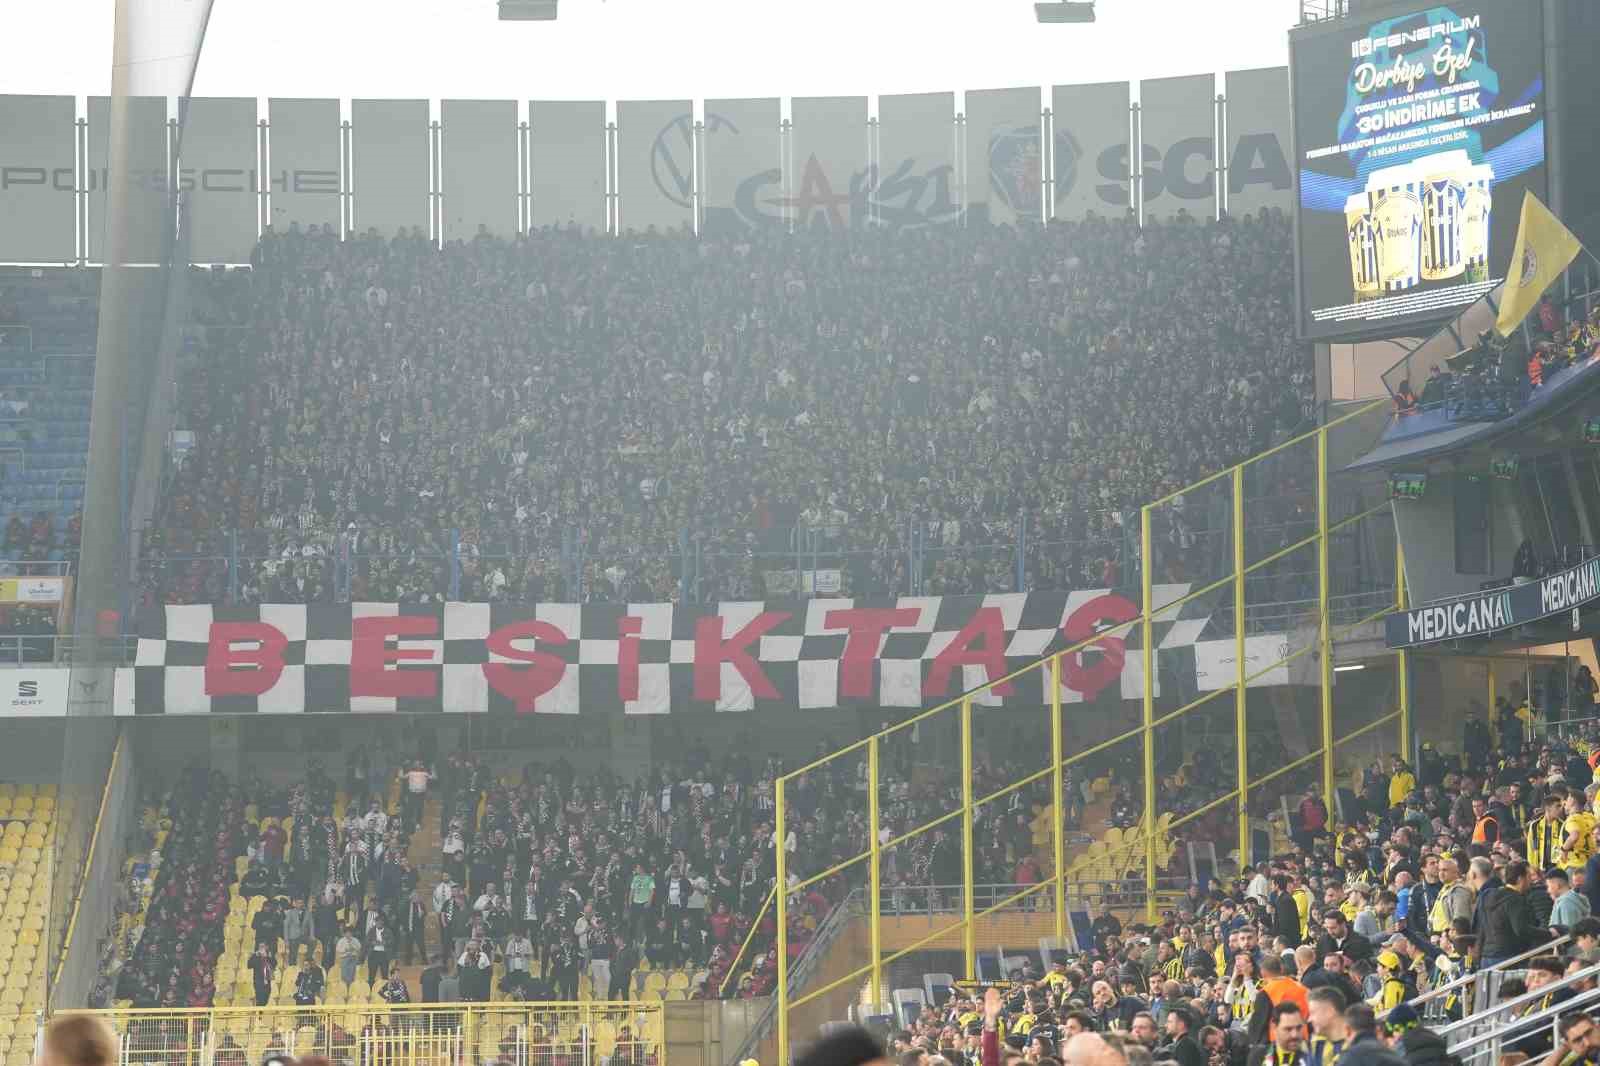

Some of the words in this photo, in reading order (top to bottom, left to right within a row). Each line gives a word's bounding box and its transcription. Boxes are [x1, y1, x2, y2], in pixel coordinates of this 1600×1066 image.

[1355, 54, 1425, 93] Derbiye
[1433, 37, 1475, 83] Özel
[1384, 97, 1457, 128] İNDİRİME
[1459, 92, 1480, 113] EK
[1541, 562, 1596, 614] MEDICANA
[1408, 596, 1506, 643] MEDICANA
